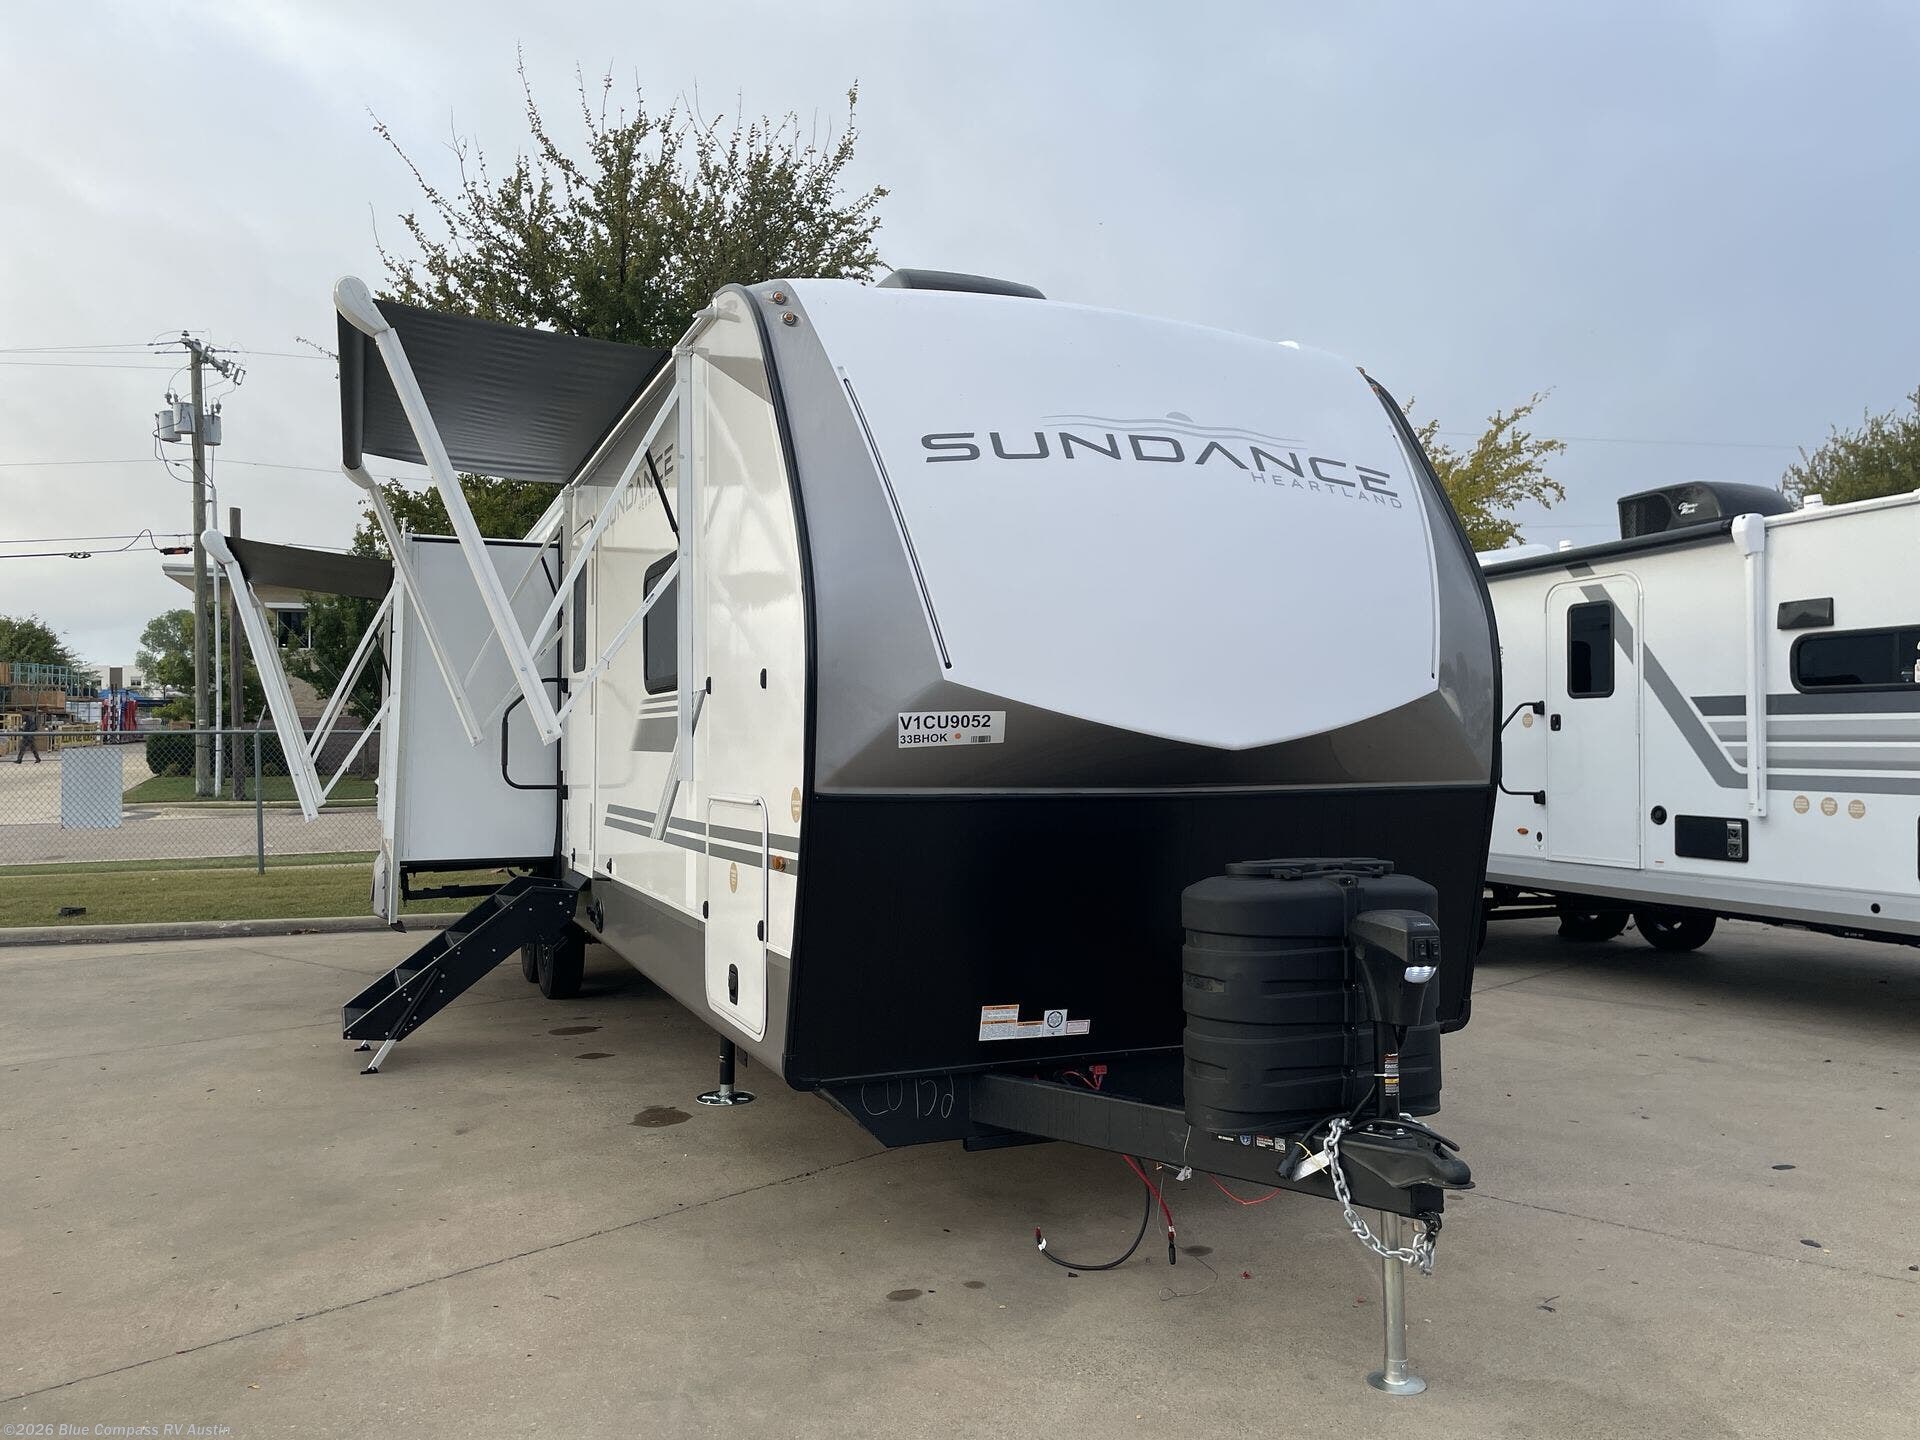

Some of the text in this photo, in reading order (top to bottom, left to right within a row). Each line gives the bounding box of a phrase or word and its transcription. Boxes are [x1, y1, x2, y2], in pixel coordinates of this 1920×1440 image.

[921, 432, 1398, 498] SUNDANCE
[1251, 471, 1402, 509] HEARTLAND
[900, 714, 991, 730] V1CU9052
[900, 733, 948, 744] 33BHOK
